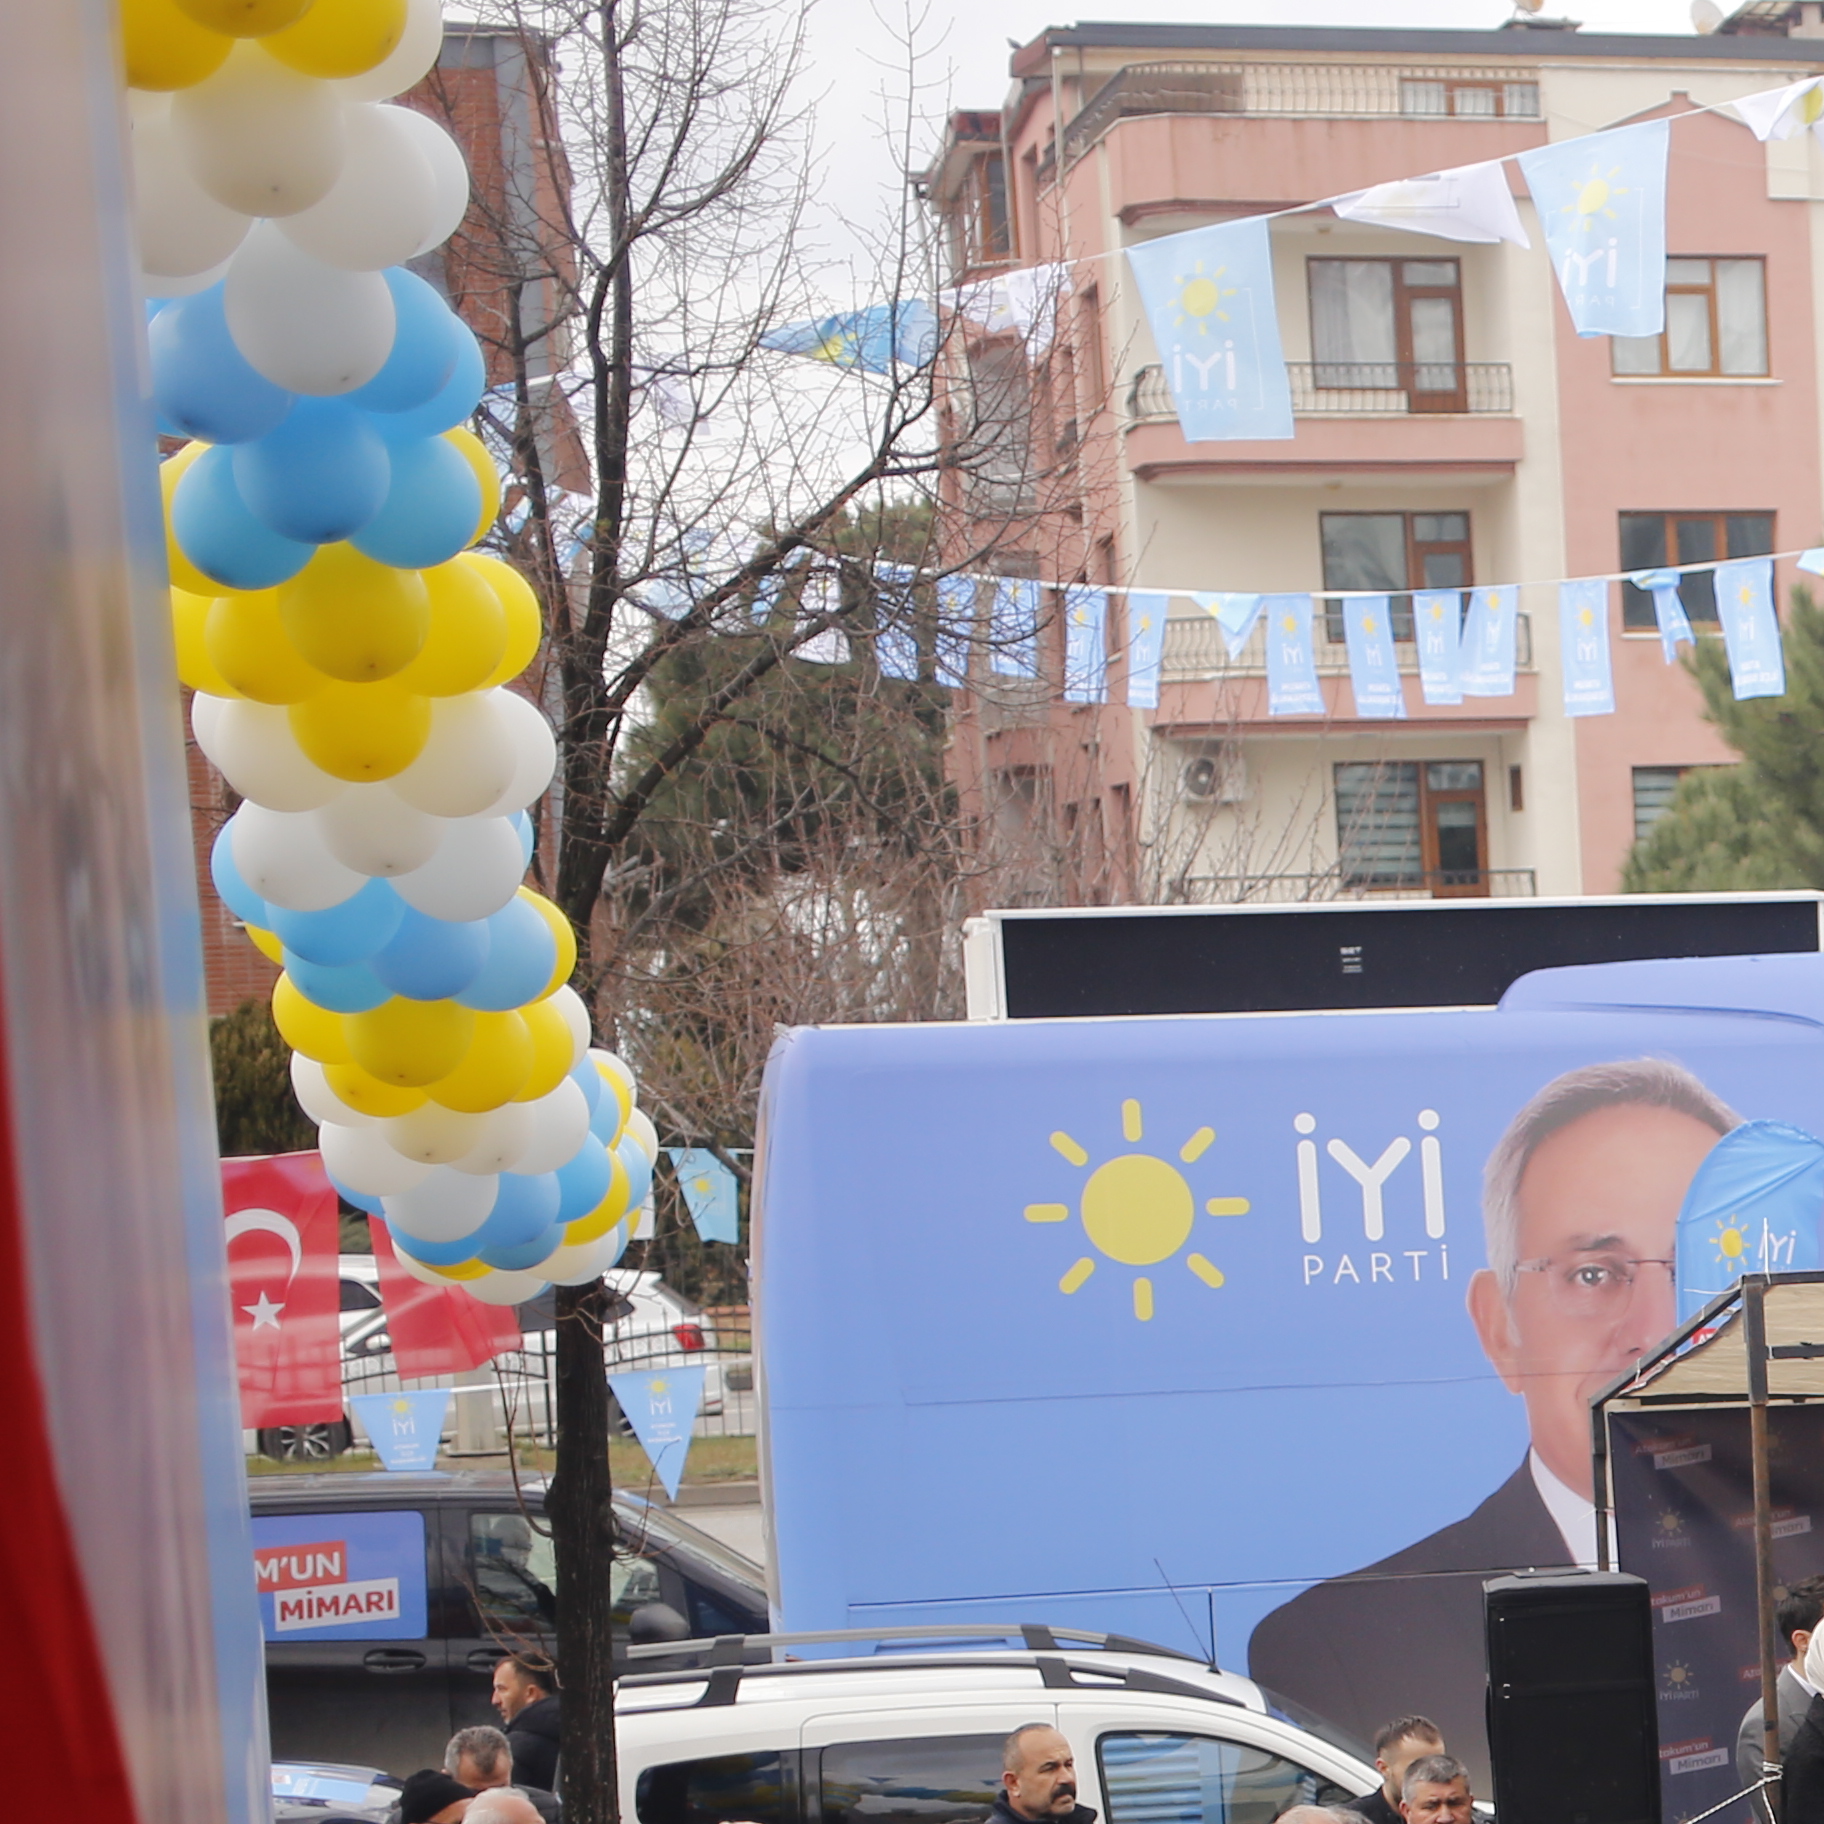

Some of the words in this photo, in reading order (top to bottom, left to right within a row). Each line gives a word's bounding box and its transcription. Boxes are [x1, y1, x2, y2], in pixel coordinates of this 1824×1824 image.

[1294, 1109, 1446, 1244] İYİ
[1303, 1243, 1449, 1286] PARTİ
[280, 1590, 394, 1622] MİMARI
[1651, 1589, 1701, 1606] takum'un
[1670, 1603, 1714, 1619] Mimarı
[1659, 1741, 1709, 1758] takum'un
[1678, 1755, 1721, 1771] Mimarı
